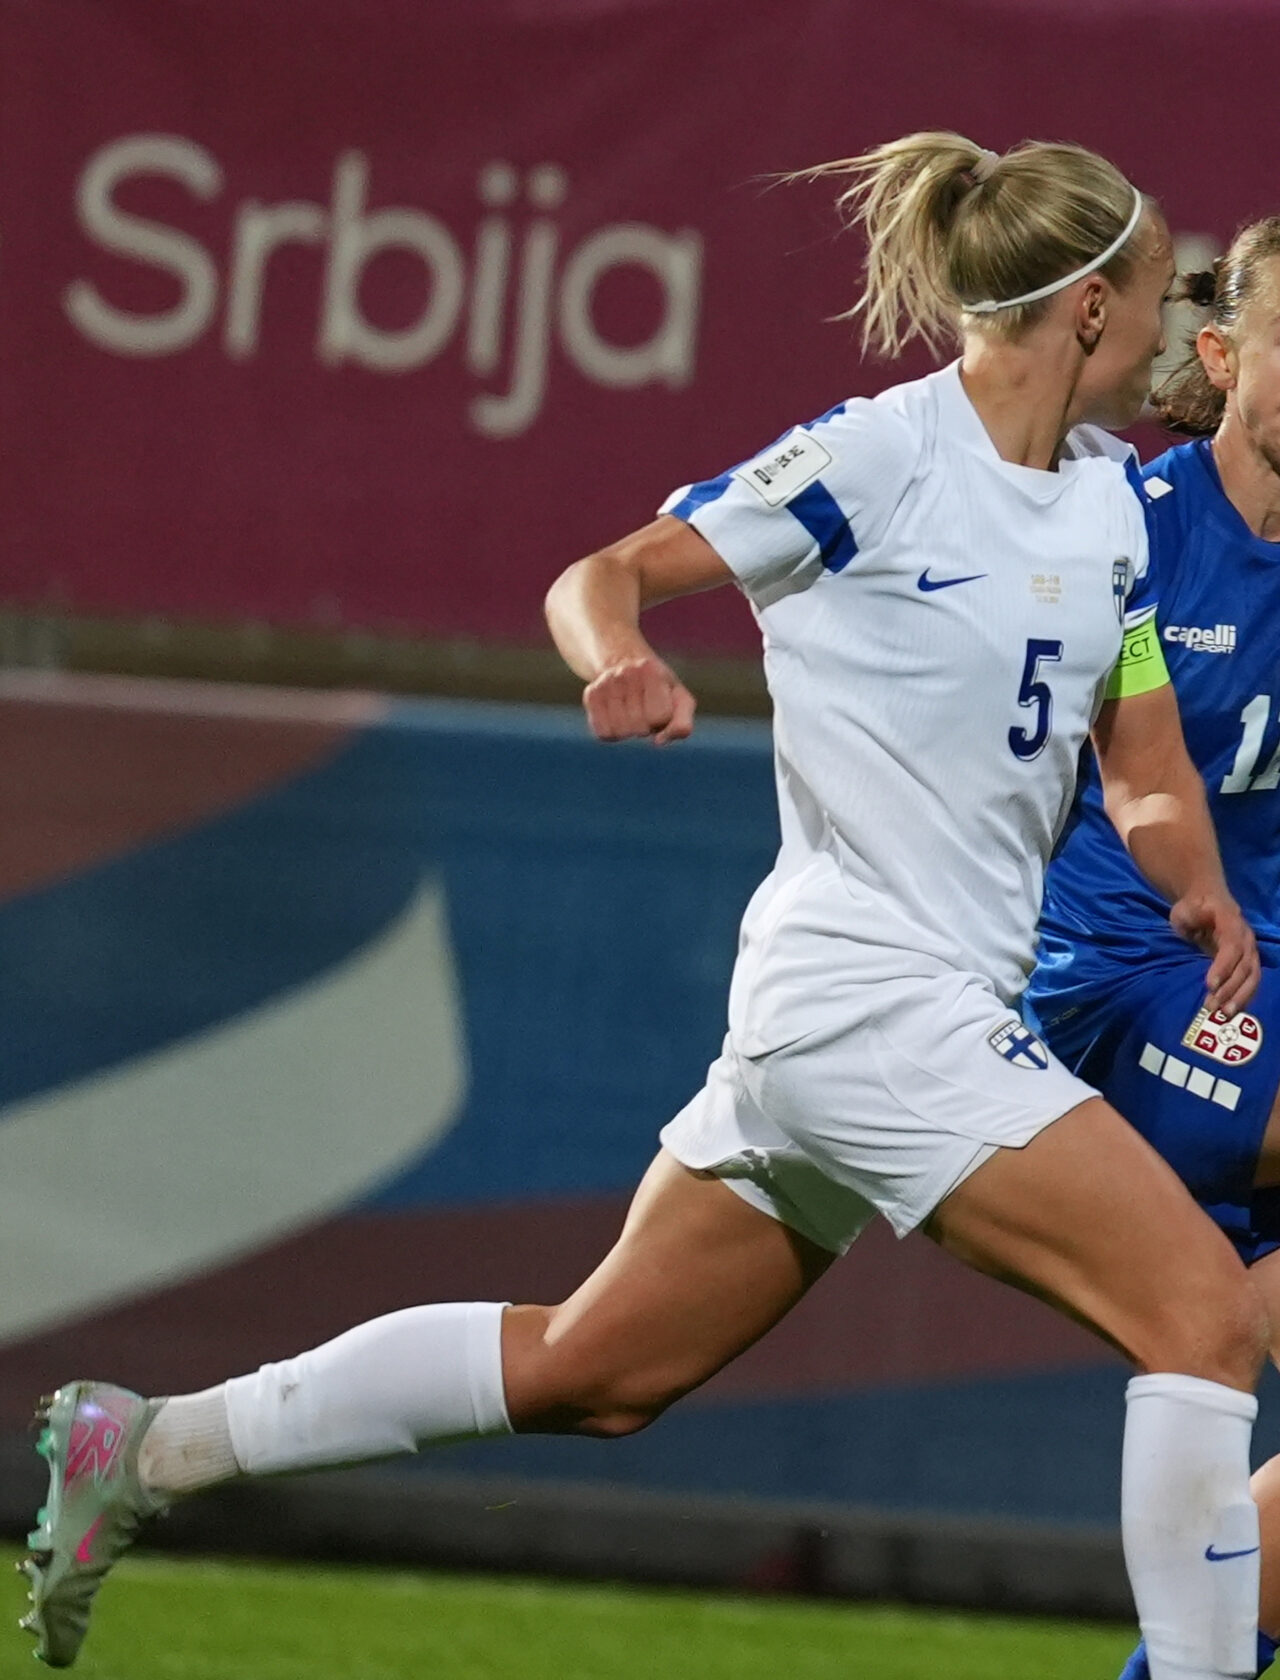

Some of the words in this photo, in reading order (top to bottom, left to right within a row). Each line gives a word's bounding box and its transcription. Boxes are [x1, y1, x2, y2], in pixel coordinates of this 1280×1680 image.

[66, 134, 702, 438] Srbija
[1164, 624, 1236, 648] capelli
[1192, 643, 1235, 654] SPORT
[1008, 638, 1064, 762] 5
